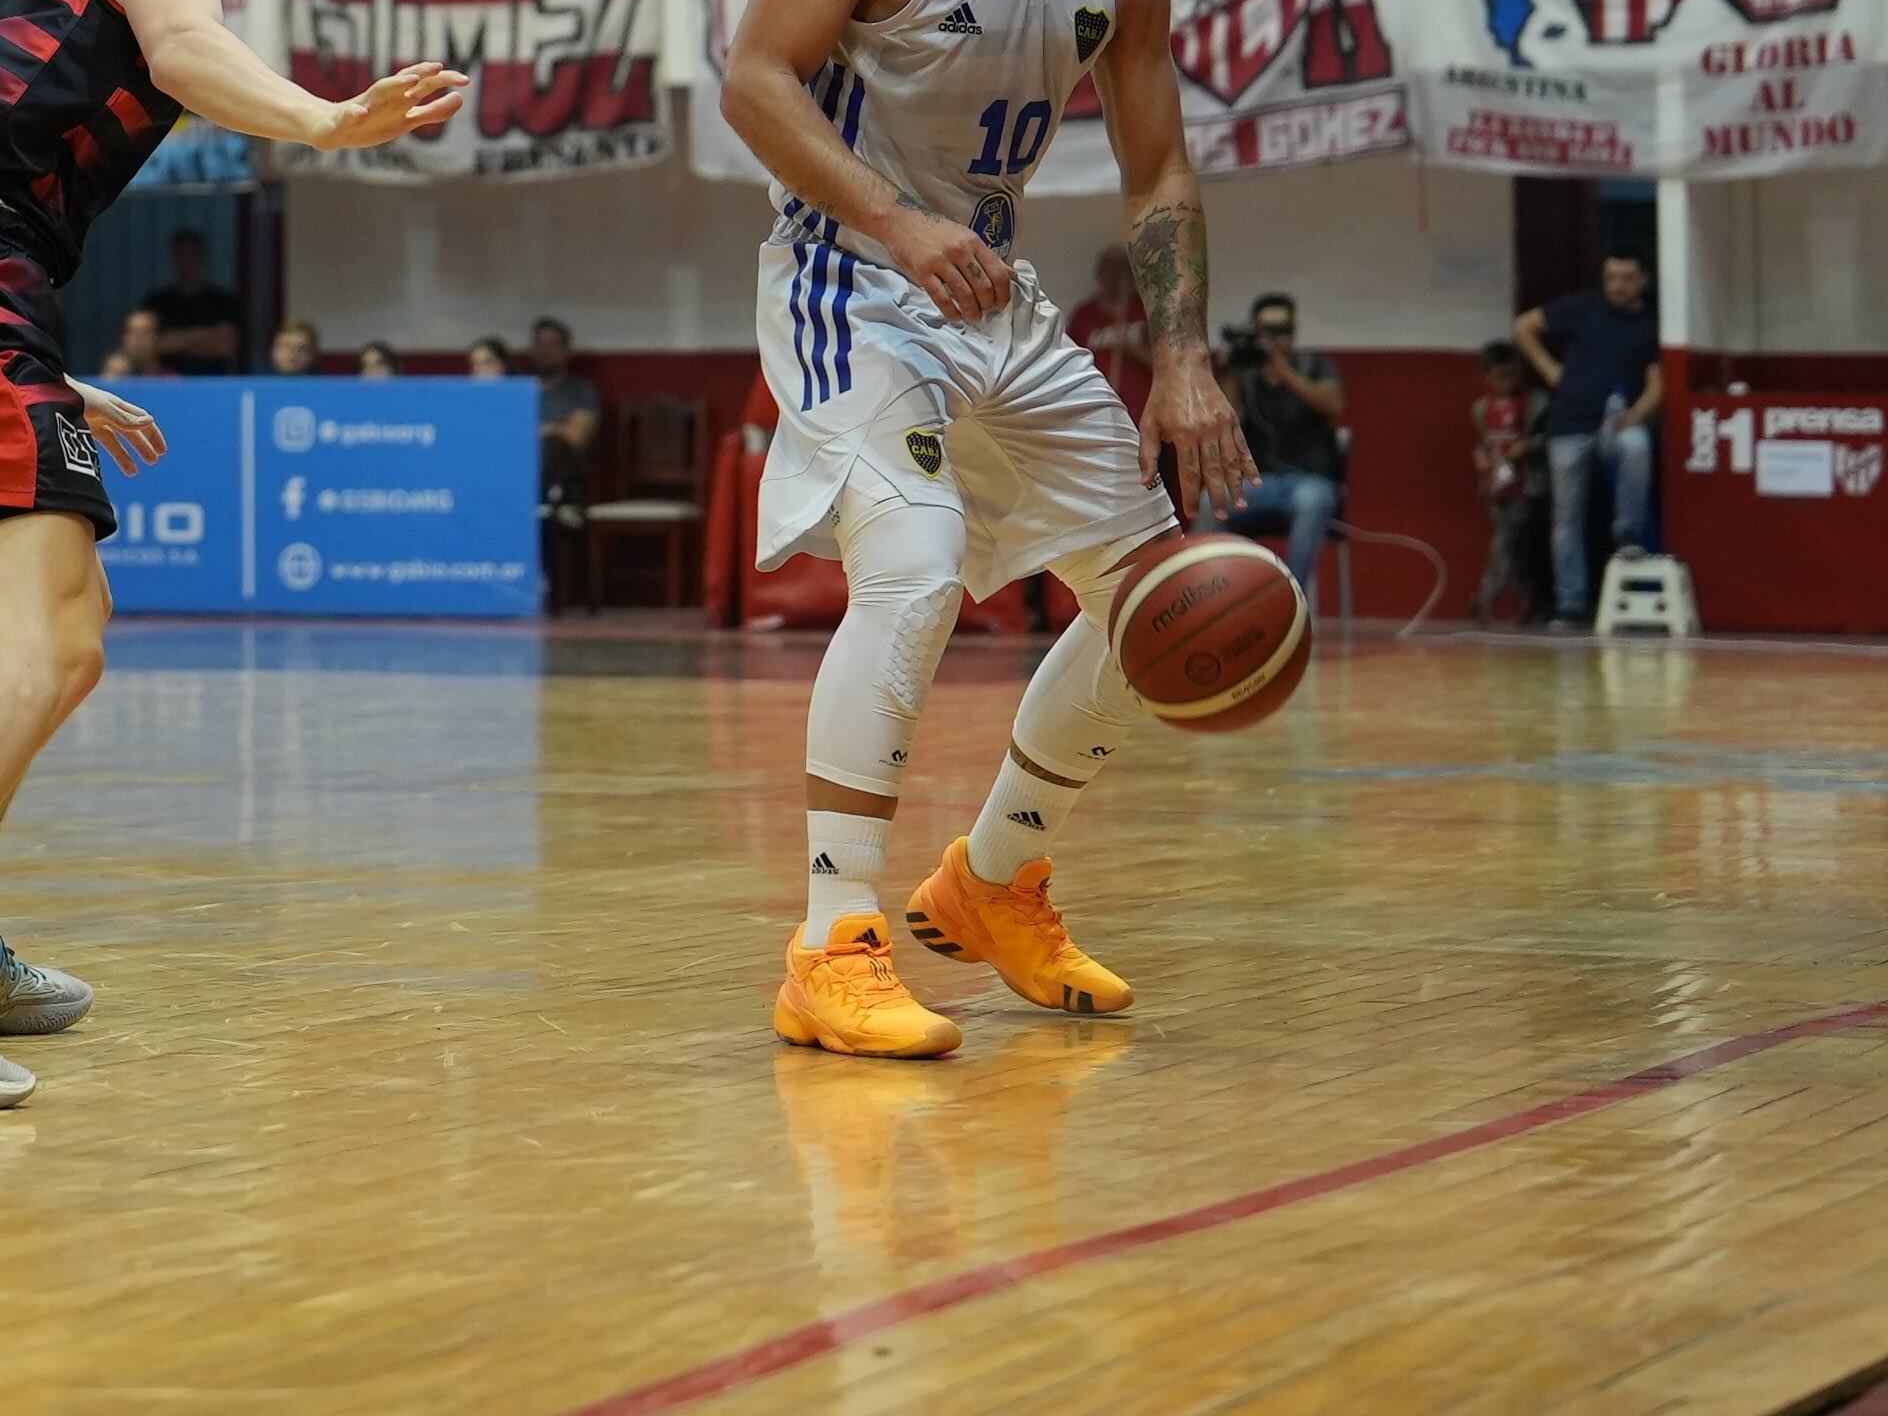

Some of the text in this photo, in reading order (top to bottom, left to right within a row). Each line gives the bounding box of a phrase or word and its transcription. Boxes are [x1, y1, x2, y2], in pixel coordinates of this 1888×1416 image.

[938, 21, 983, 35] adidas
[1700, 31, 1857, 75] GLORIA
[1750, 79, 1806, 112] AL
[967, 99, 1052, 176] 10
[1701, 114, 1857, 157] MUNDO
